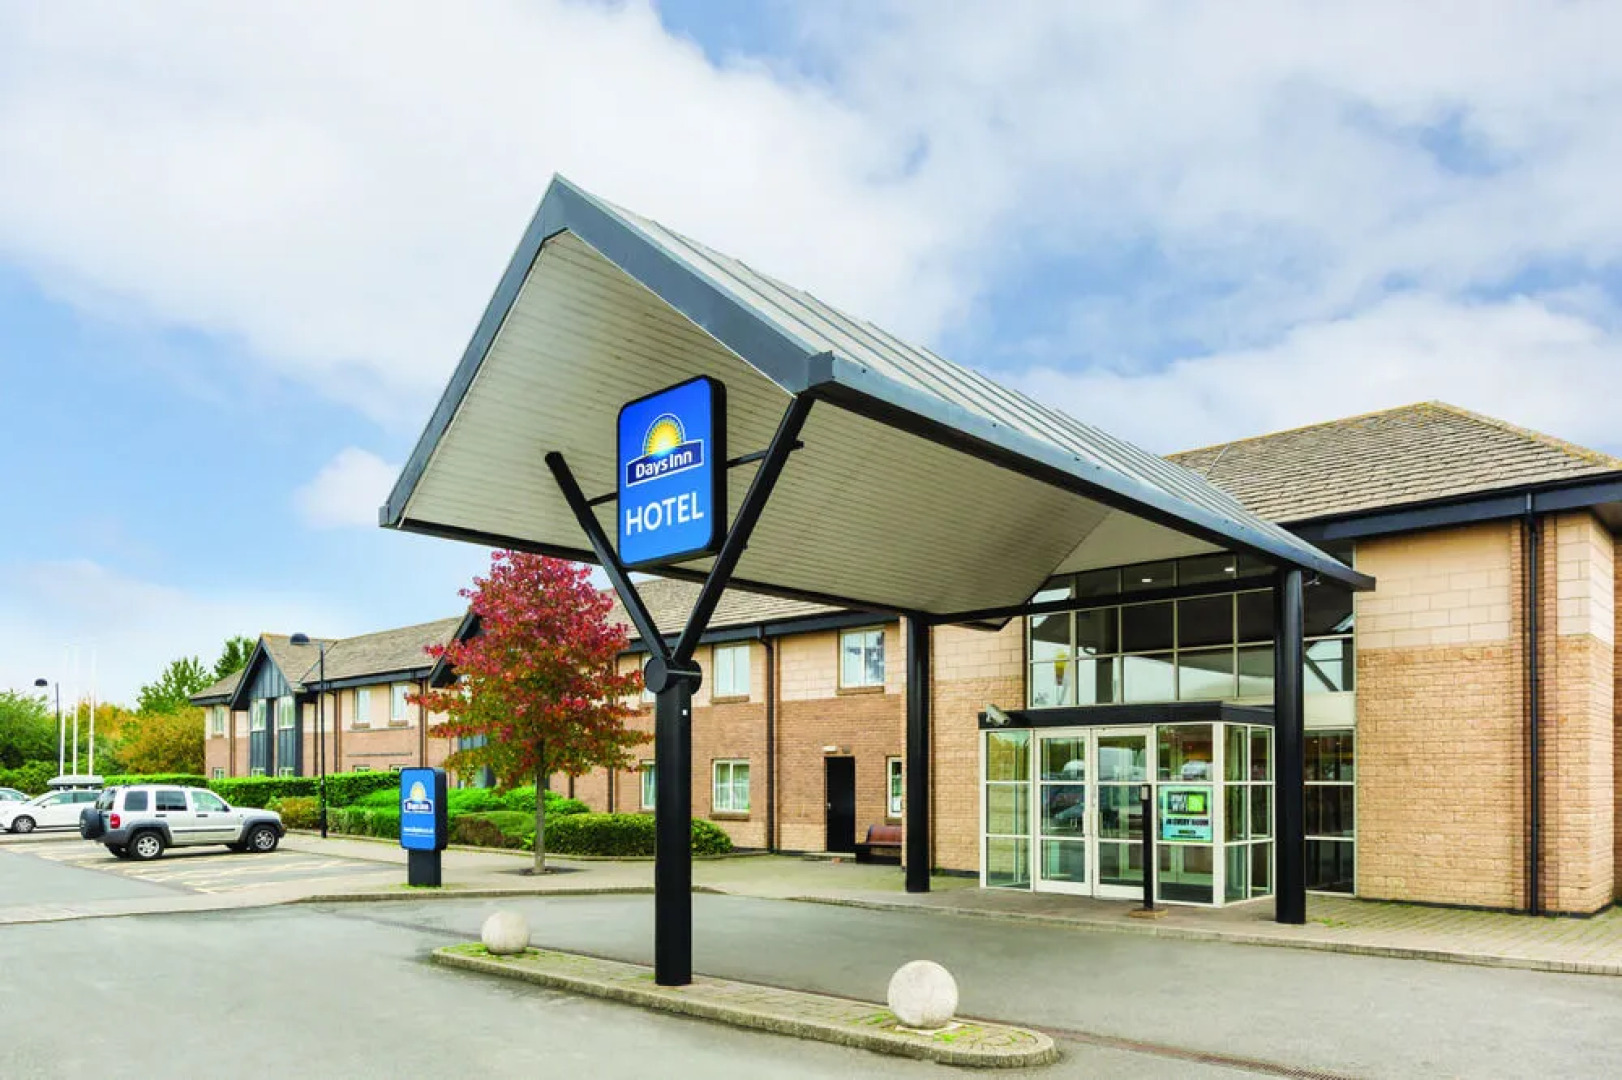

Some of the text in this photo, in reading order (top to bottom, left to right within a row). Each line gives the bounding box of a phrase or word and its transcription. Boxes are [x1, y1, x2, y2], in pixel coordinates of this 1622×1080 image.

[635, 450, 692, 479] Days Inn
[626, 491, 704, 536] HOTEL
